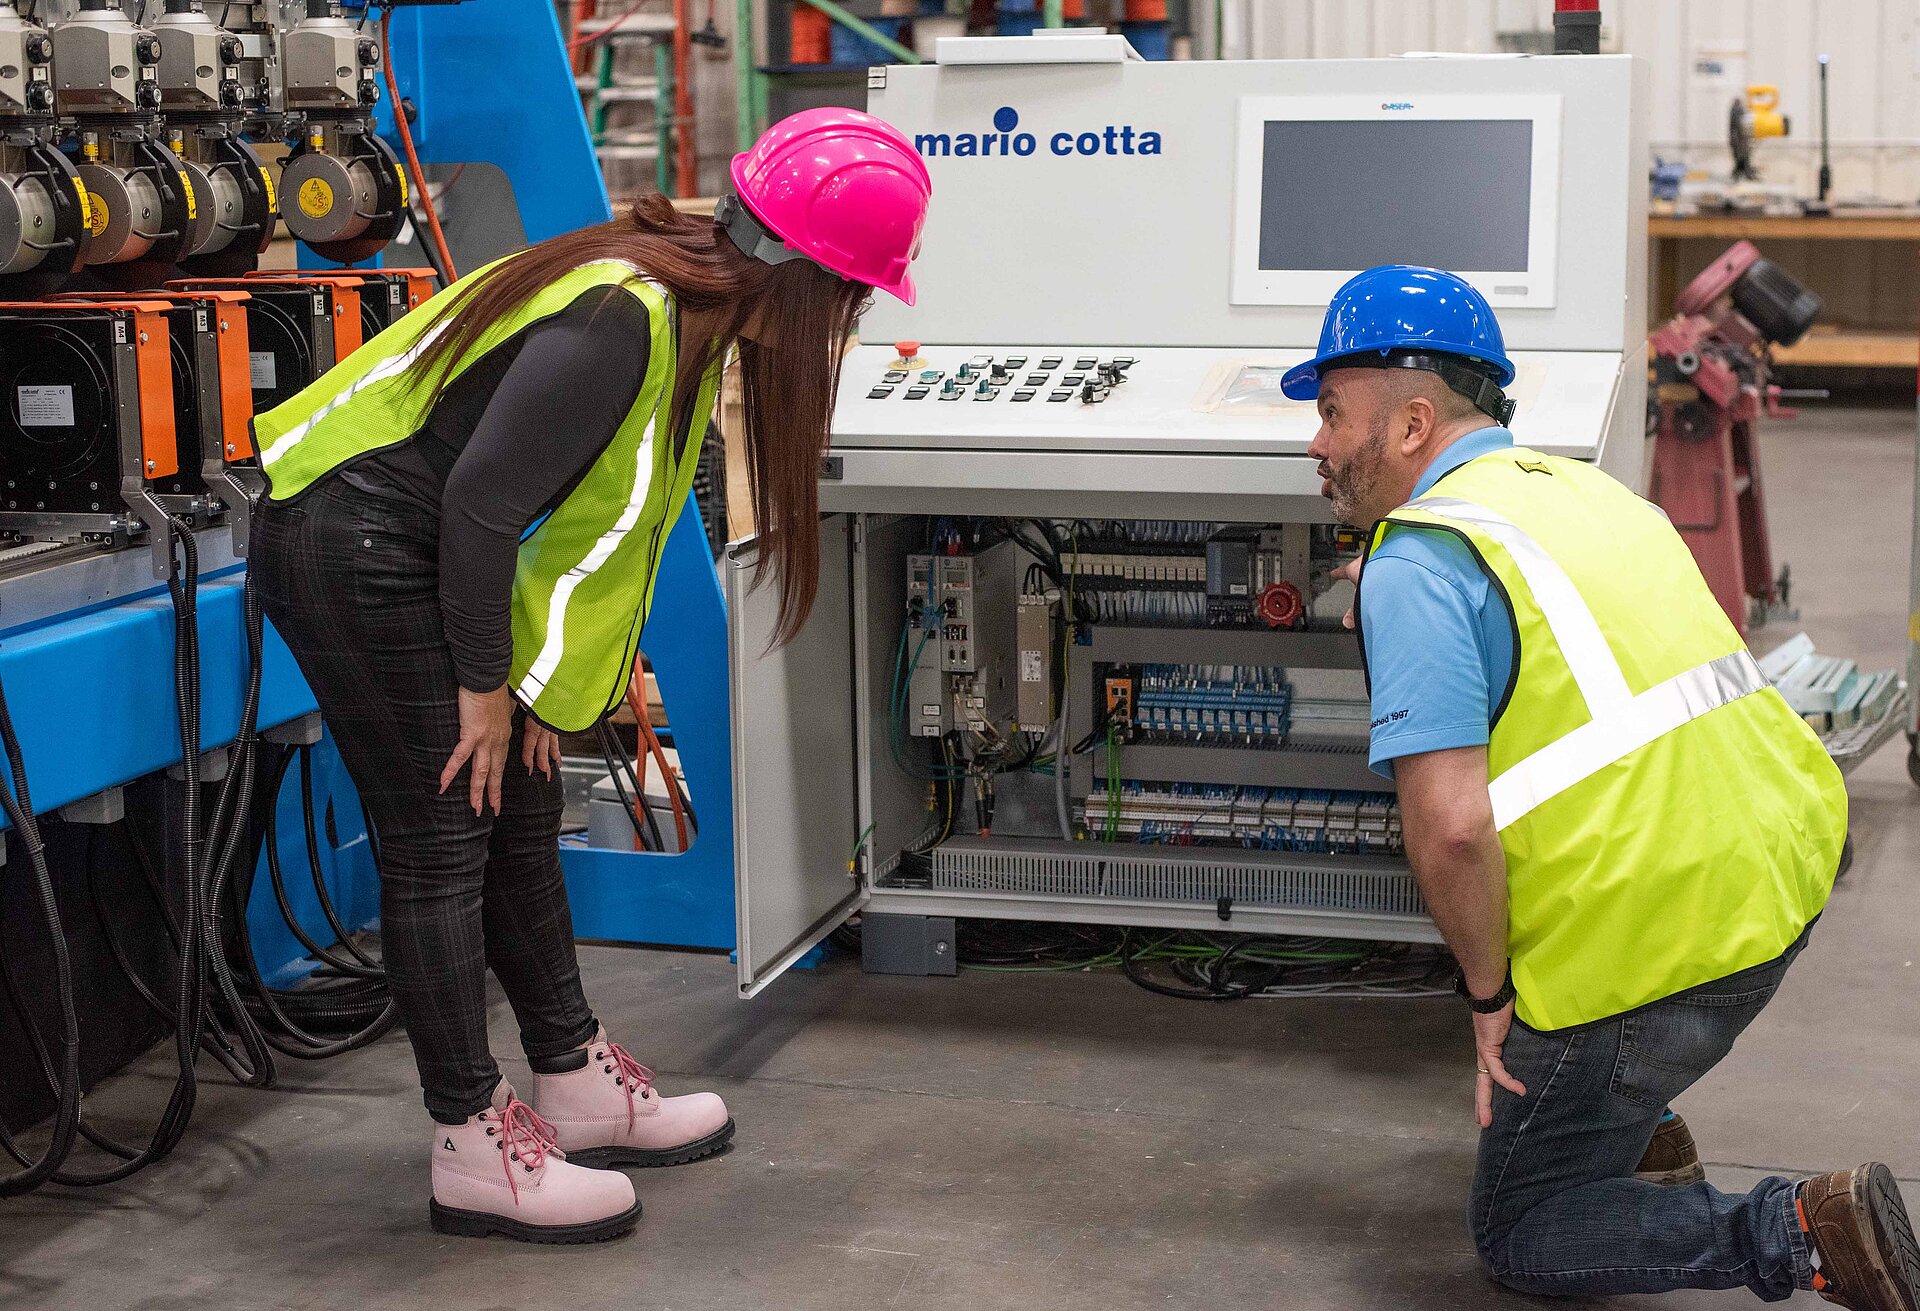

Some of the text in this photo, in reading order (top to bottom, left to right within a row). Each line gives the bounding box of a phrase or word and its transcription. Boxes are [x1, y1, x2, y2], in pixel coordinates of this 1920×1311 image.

[914, 106, 1162, 157] mario cotta
[392, 288, 399, 299] M1
[316, 299, 323, 311] M2
[199, 315, 207, 327] M3
[118, 325, 125, 338] M4
[1390, 709, 1410, 722] 1997
